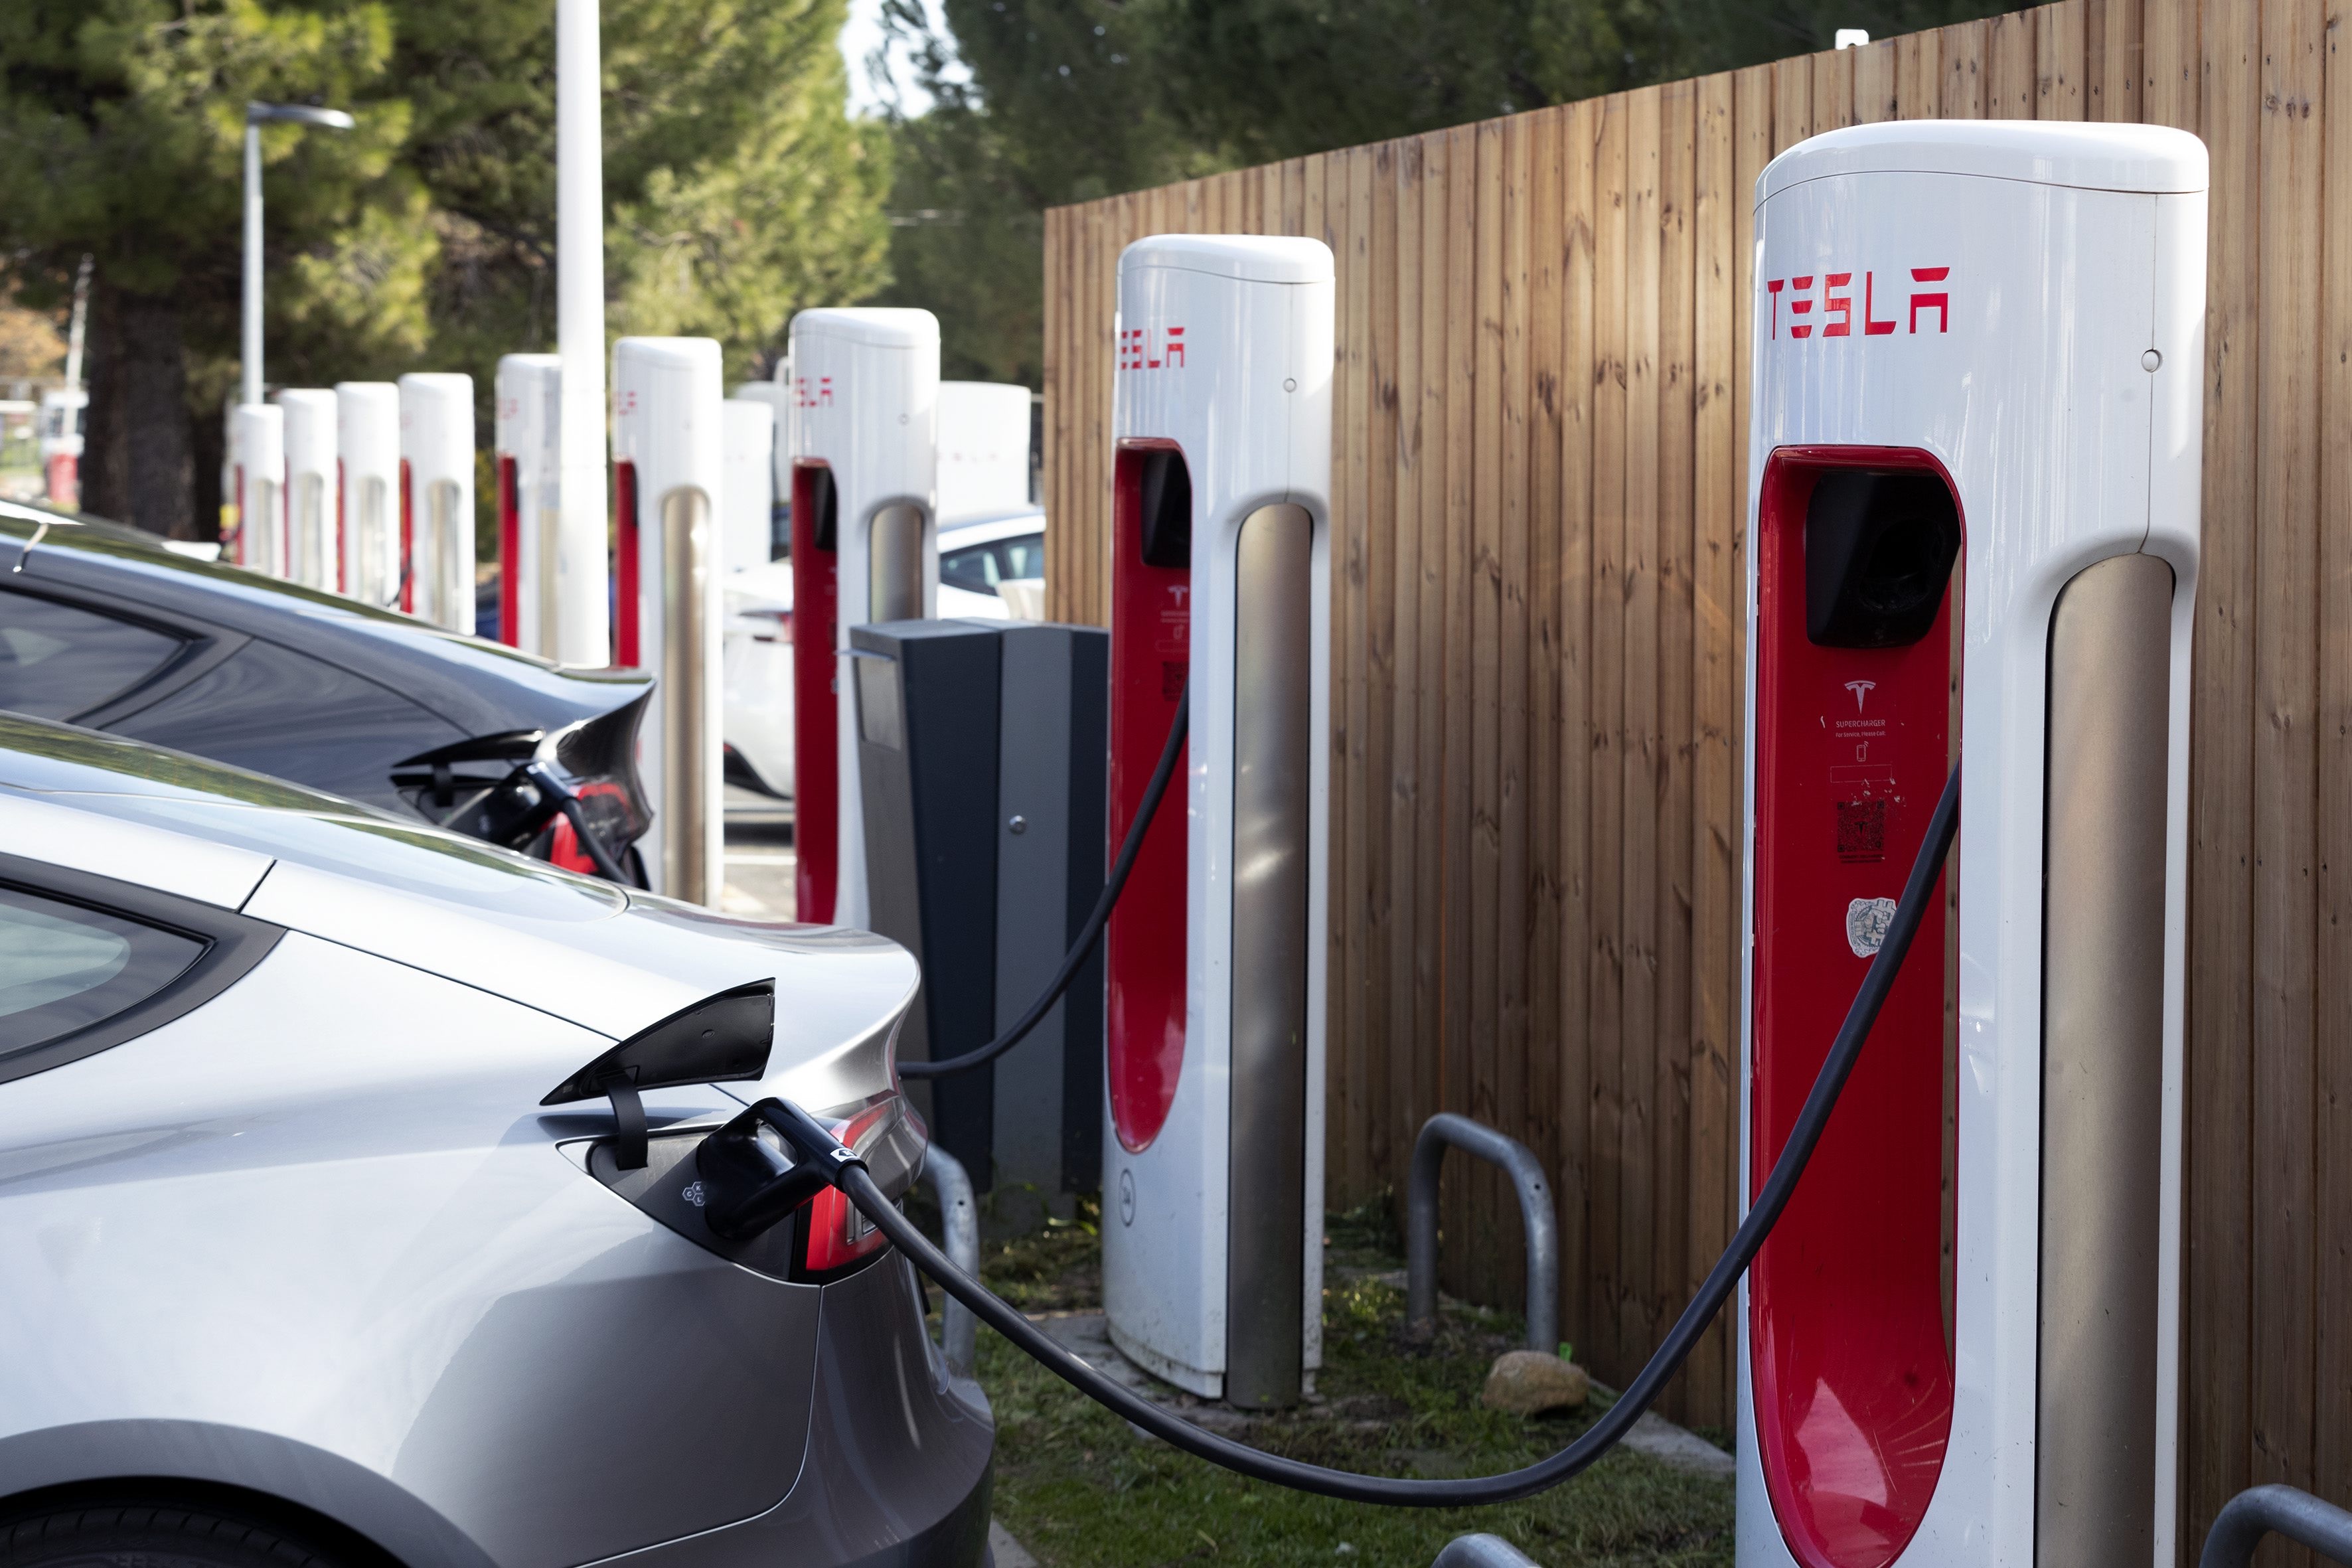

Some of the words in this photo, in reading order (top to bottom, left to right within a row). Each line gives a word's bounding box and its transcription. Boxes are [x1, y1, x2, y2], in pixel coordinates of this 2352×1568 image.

[1766, 267, 1950, 341] TESLA
[1121, 327, 1186, 370] ESLA
[1836, 719, 1886, 728] SUPERCHARGER
